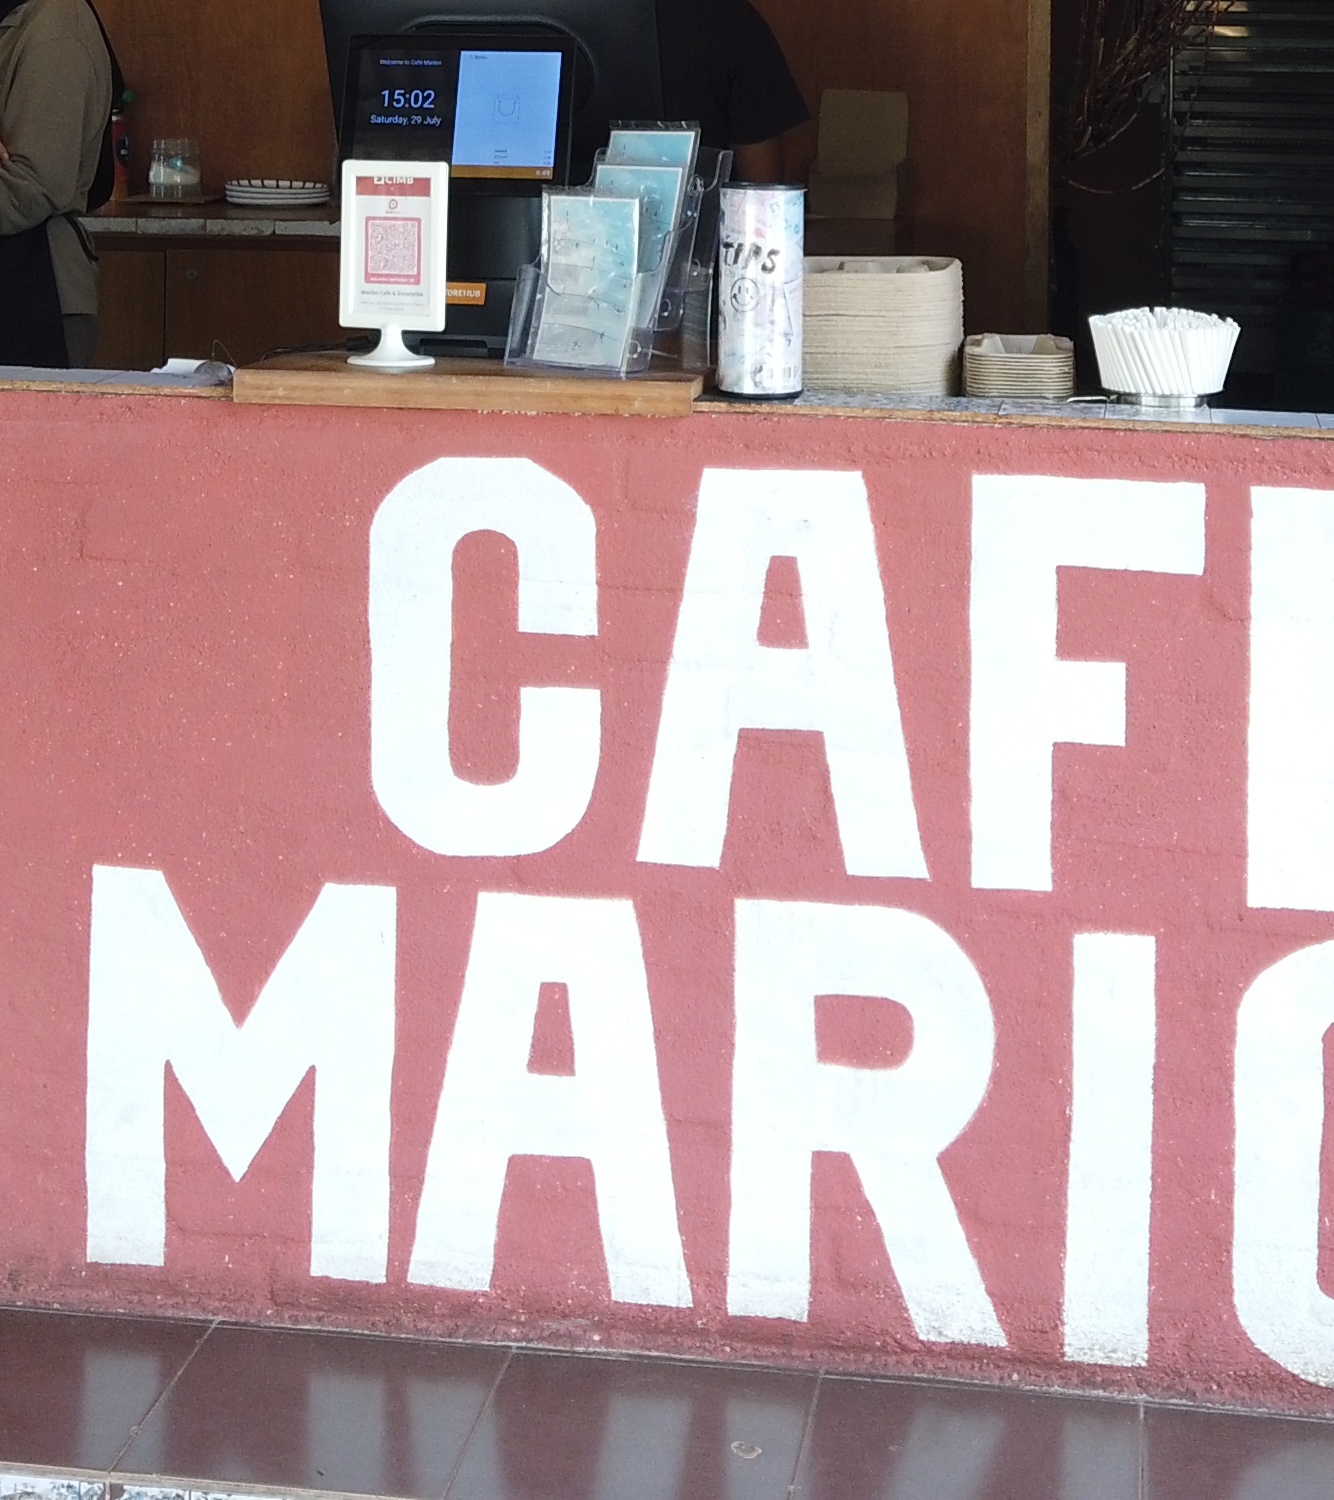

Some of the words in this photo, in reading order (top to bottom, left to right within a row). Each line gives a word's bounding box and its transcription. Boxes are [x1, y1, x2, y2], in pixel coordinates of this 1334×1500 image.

[380, 89, 436, 109] 15:02
[370, 114, 409, 126] Saturday,
[410, 115, 423, 125] 29
[423, 115, 442, 127] July
[385, 176, 414, 184] CIMB
[722, 240, 781, 275] TIPS
[446, 289, 481, 298] OREHUB
